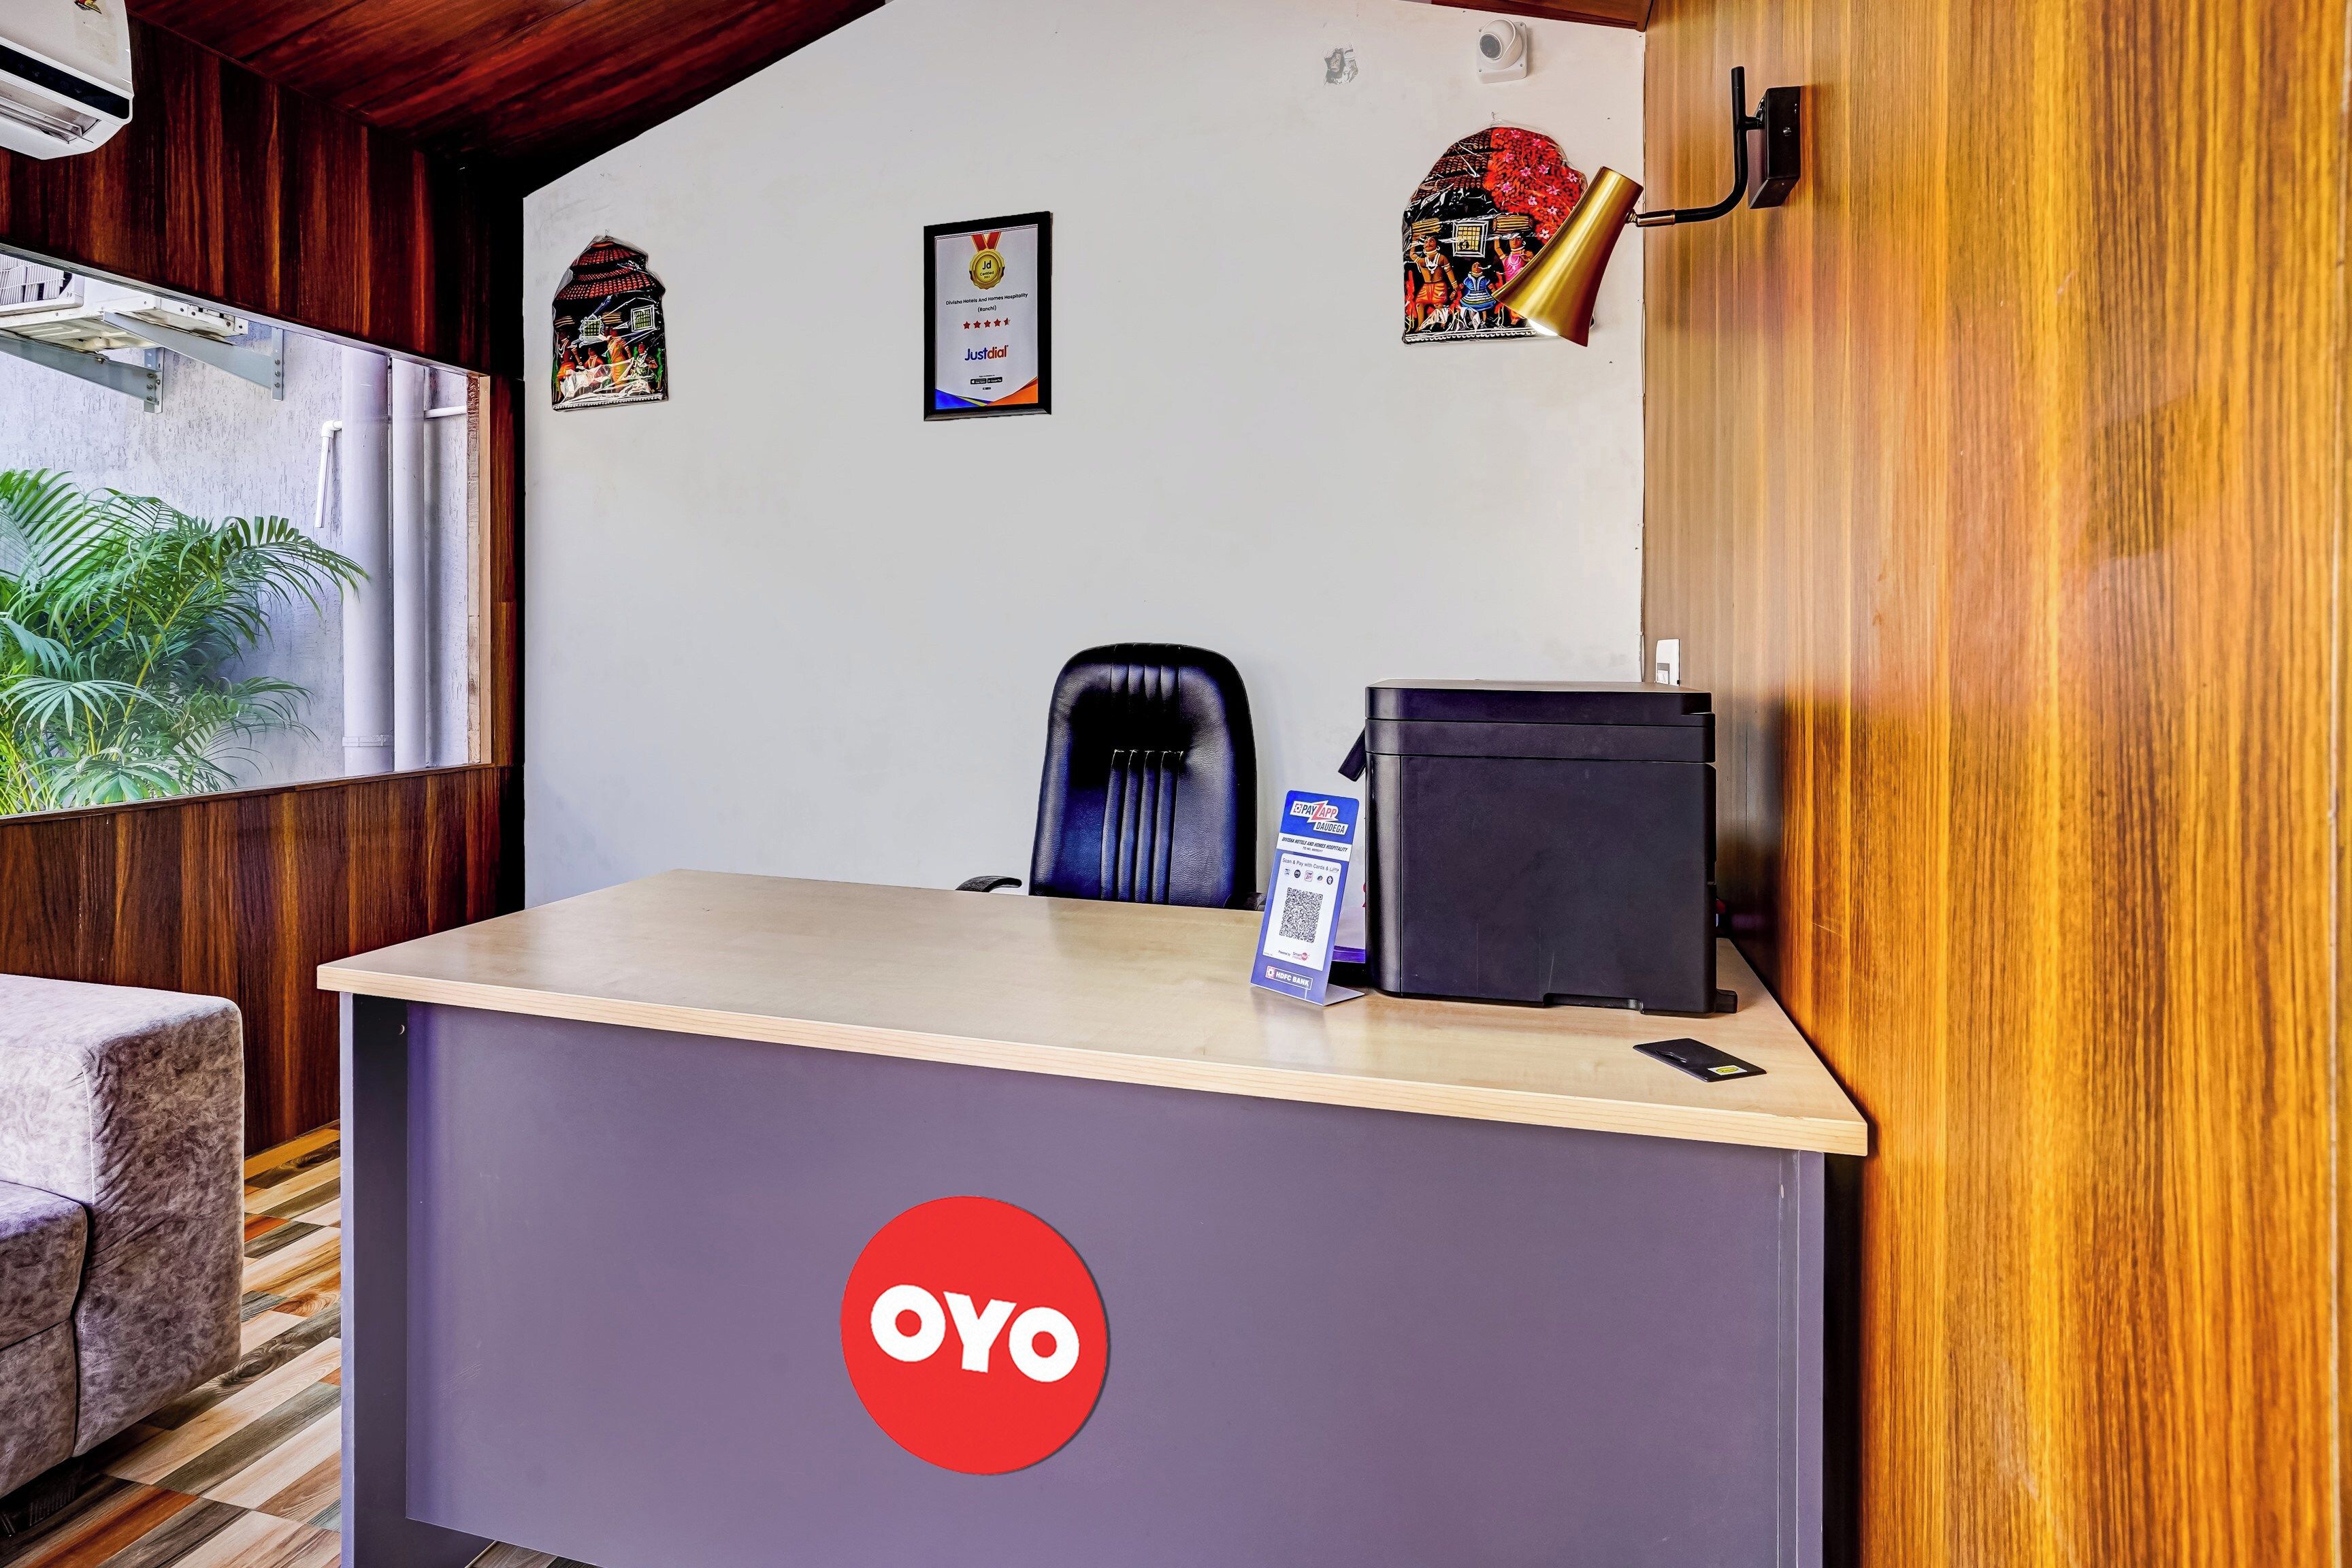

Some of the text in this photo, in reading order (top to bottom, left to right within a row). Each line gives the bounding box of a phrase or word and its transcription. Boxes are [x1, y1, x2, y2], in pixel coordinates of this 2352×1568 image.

[982, 260, 992, 270] Jd
[977, 305, 997, 313] (Ranchi)
[964, 345, 1007, 361] Justdial
[1316, 821, 1345, 834] DAUDEGA
[1326, 844, 1348, 852] HOSPITALITY
[1275, 971, 1310, 987] HDFC BANK
[870, 1284, 1080, 1382] OYO
